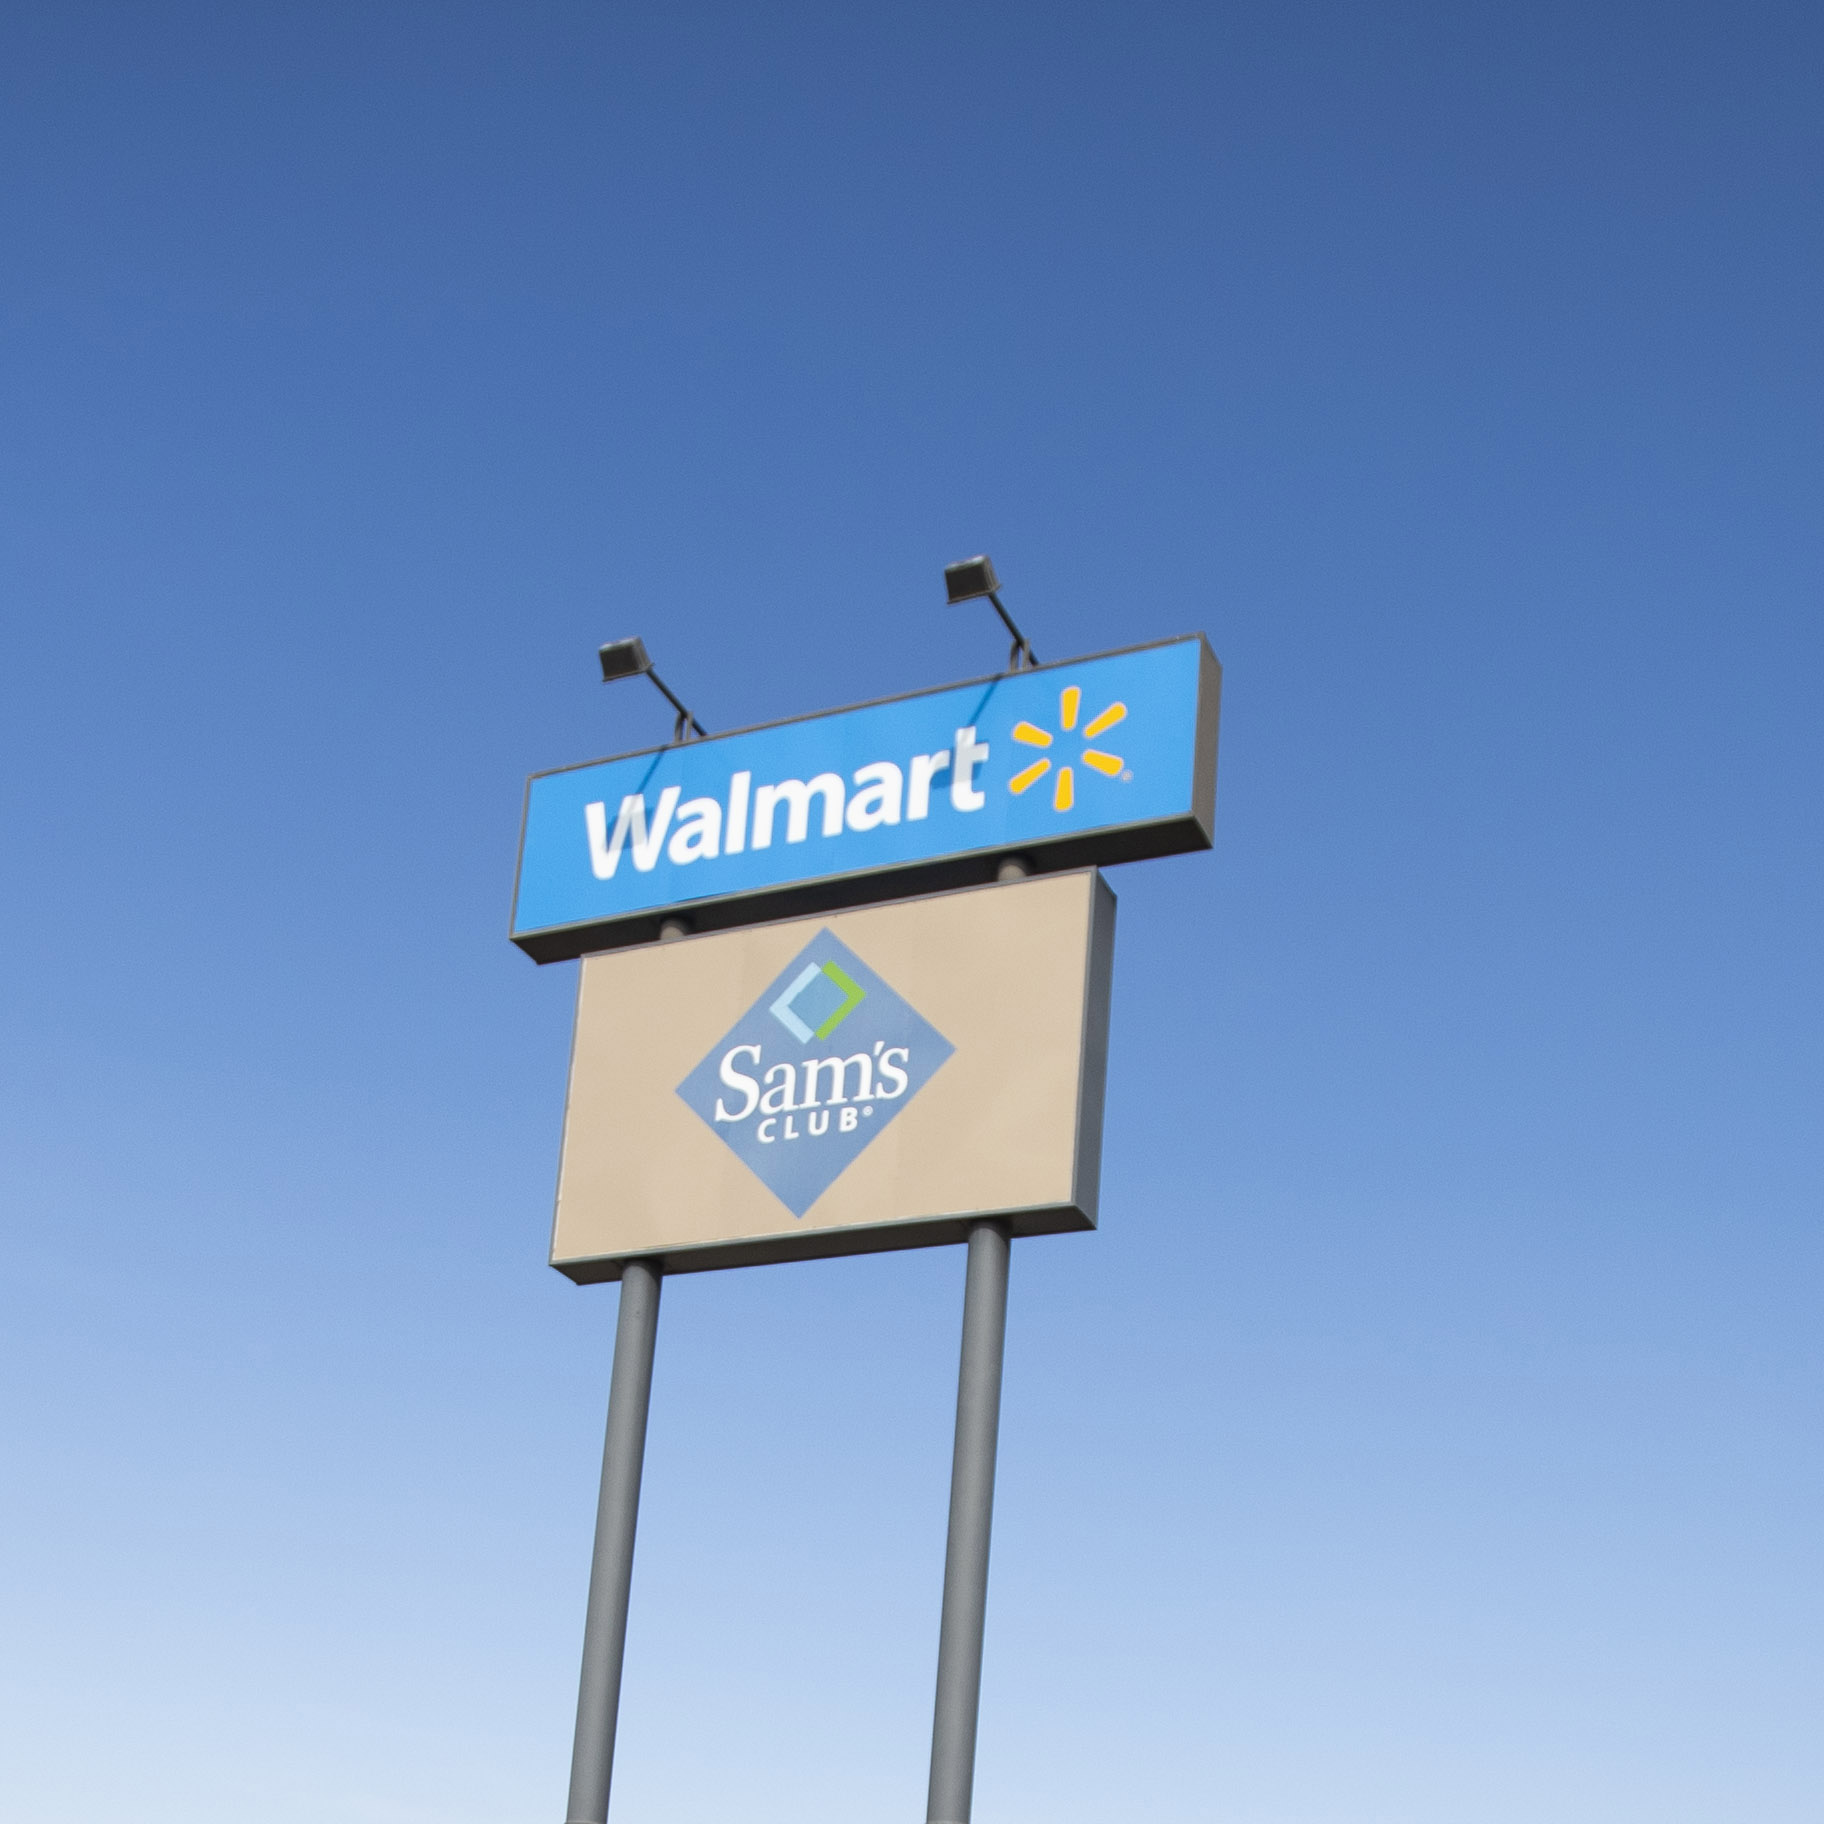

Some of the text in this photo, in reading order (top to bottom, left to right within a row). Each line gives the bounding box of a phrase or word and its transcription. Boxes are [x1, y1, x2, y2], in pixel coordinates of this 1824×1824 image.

[584, 726, 991, 880] Walmart
[715, 1039, 910, 1124] Sam's
[757, 1107, 860, 1144] CLUB
